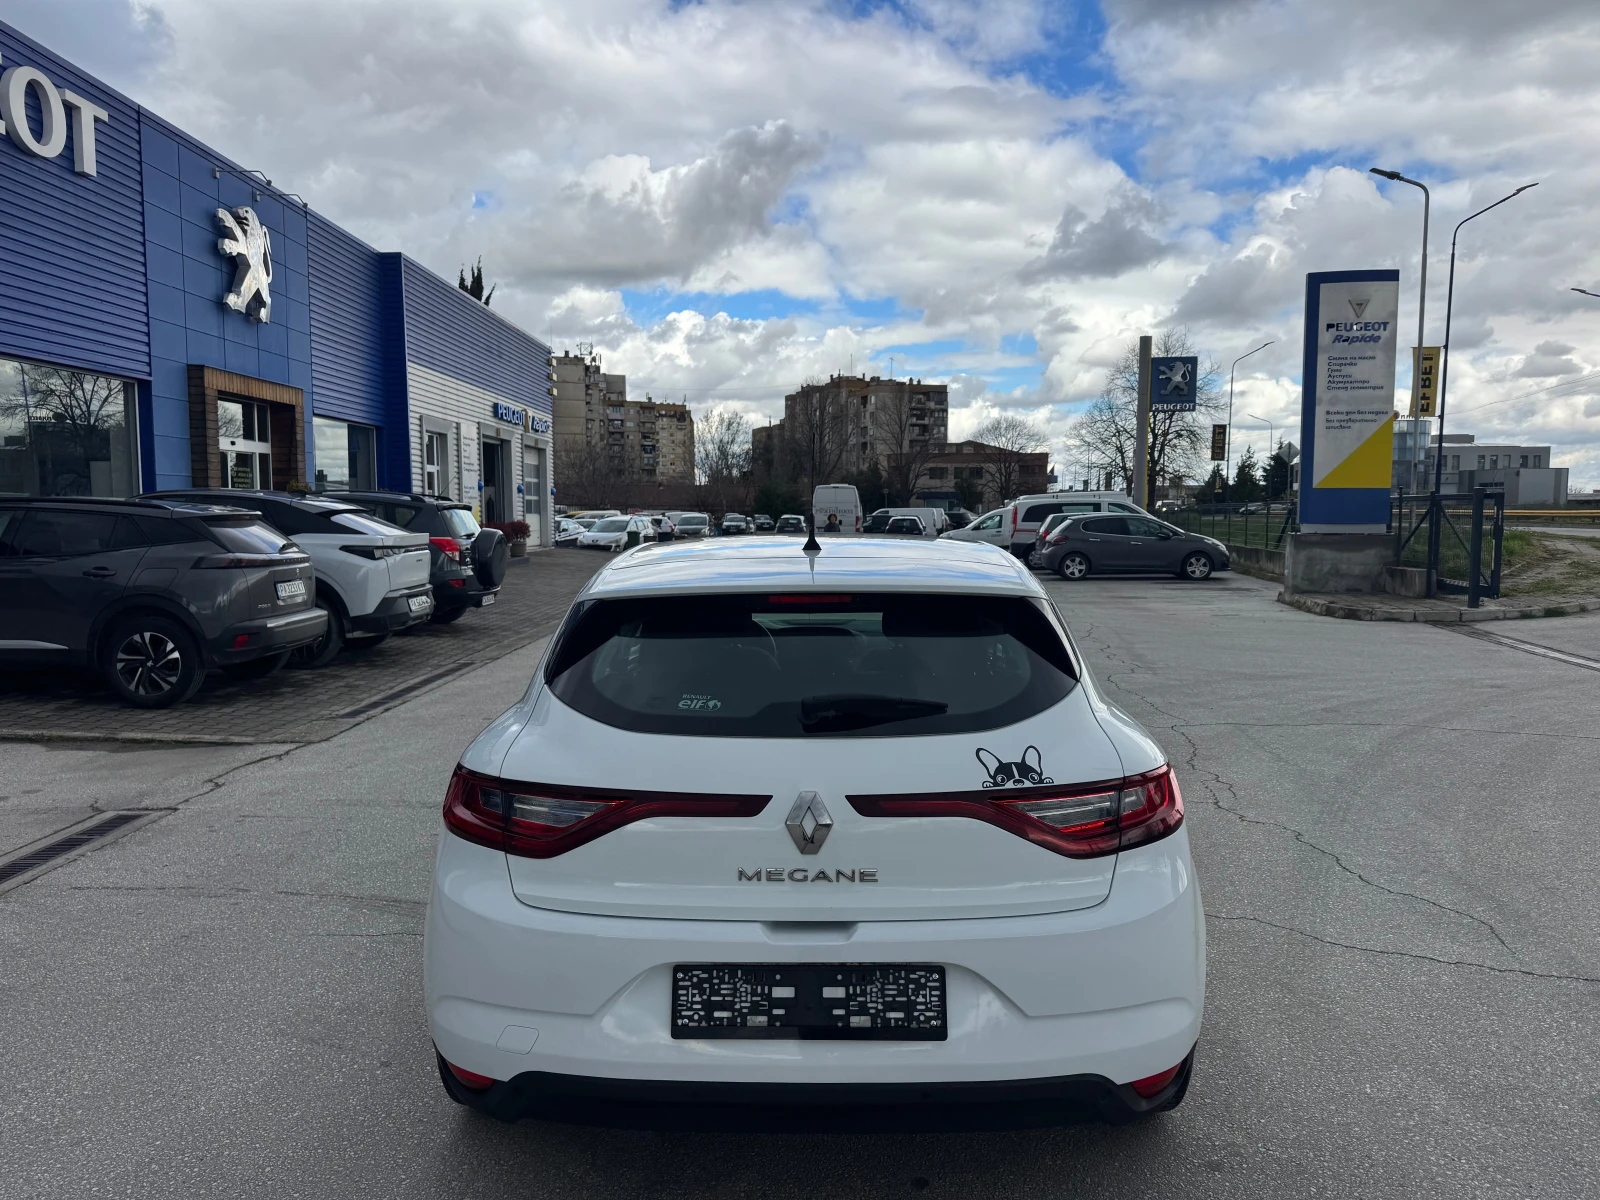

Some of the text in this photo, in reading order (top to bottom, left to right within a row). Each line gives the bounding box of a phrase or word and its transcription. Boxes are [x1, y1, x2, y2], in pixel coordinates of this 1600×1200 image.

[0, 52, 108, 177] OT
[1326, 321, 1390, 333] PEUGEOT
[1332, 333, 1382, 345] Rapide
[1152, 403, 1195, 411] PEUGEOT
[498, 402, 526, 425] PEUGEOT
[678, 700, 706, 709] elf
[738, 867, 879, 883] MEGANE
